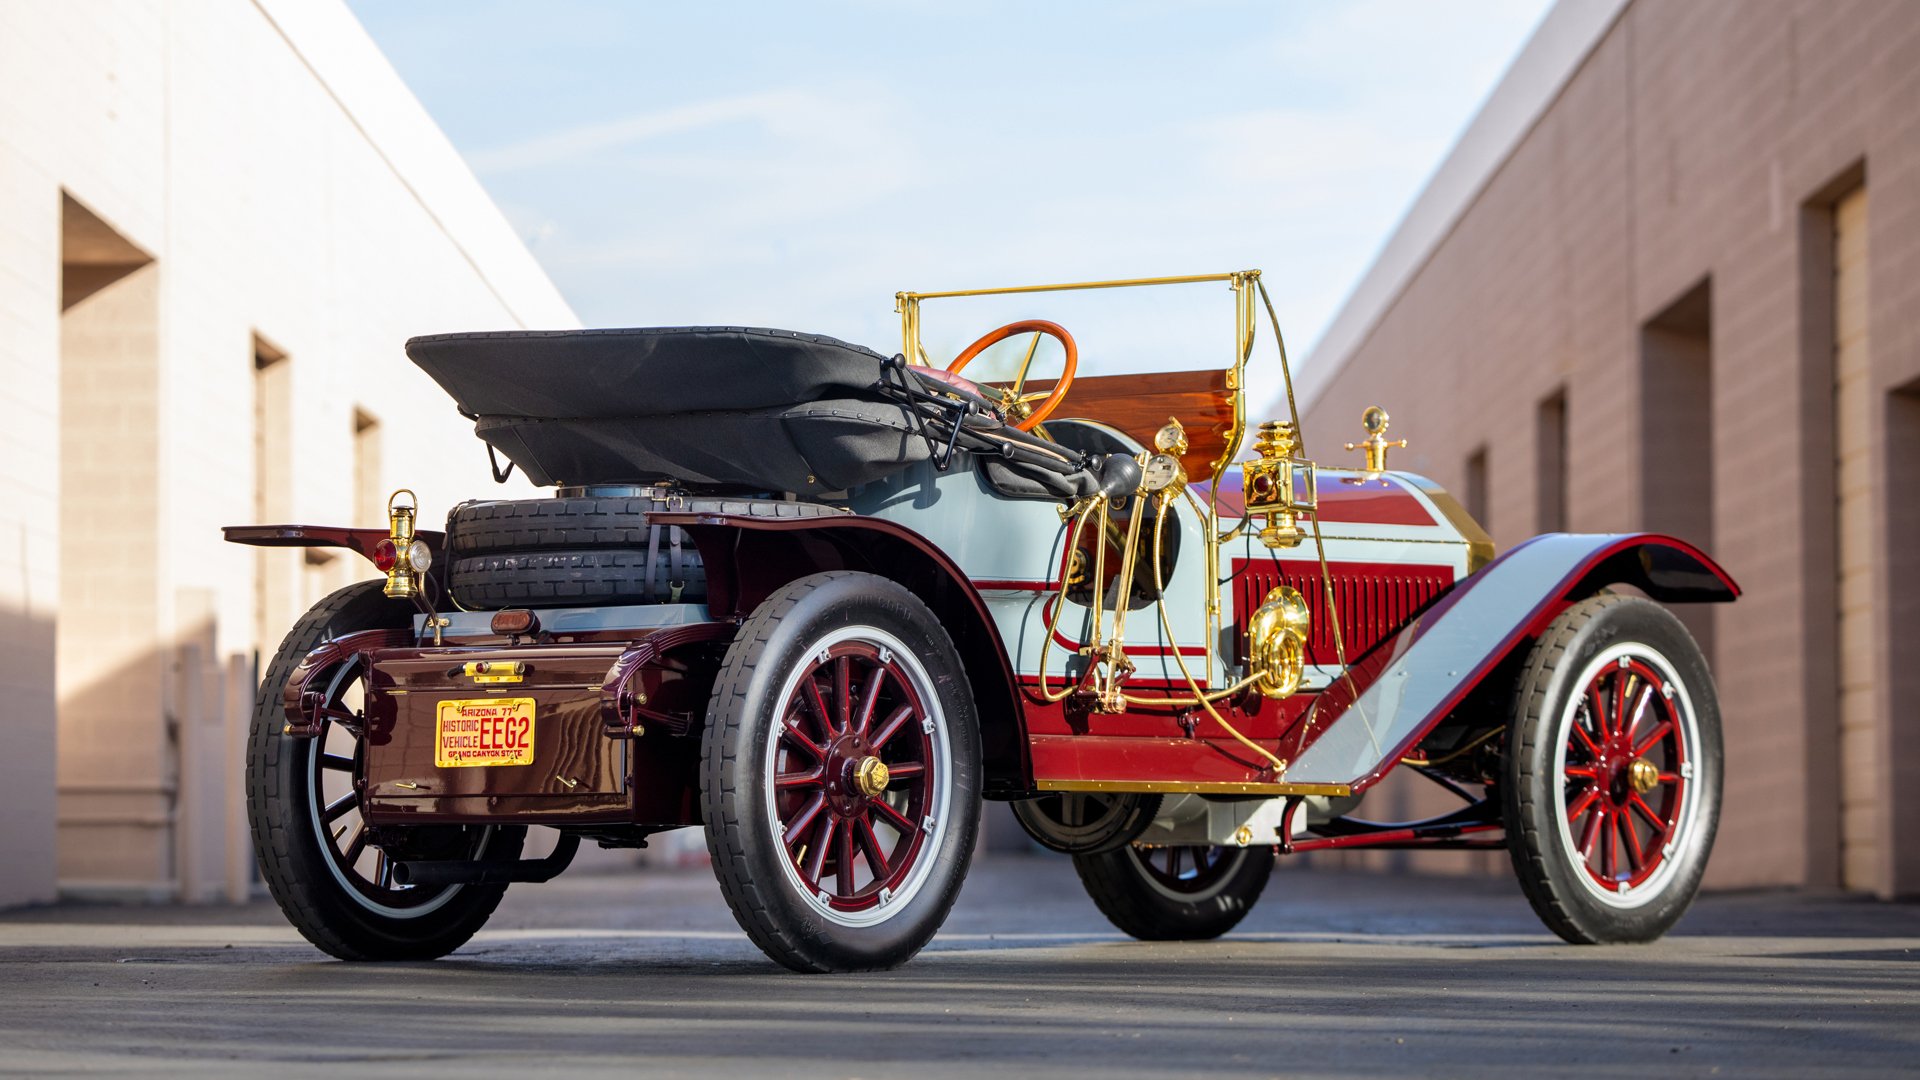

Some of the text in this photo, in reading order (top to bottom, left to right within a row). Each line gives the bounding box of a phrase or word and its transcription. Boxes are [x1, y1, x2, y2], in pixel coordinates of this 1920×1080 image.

[462, 707, 512, 717] ARIZONA 77
[443, 720, 479, 732] HISTORIC
[480, 717, 529, 749] EEG2
[443, 736, 478, 748] VEHICLE
